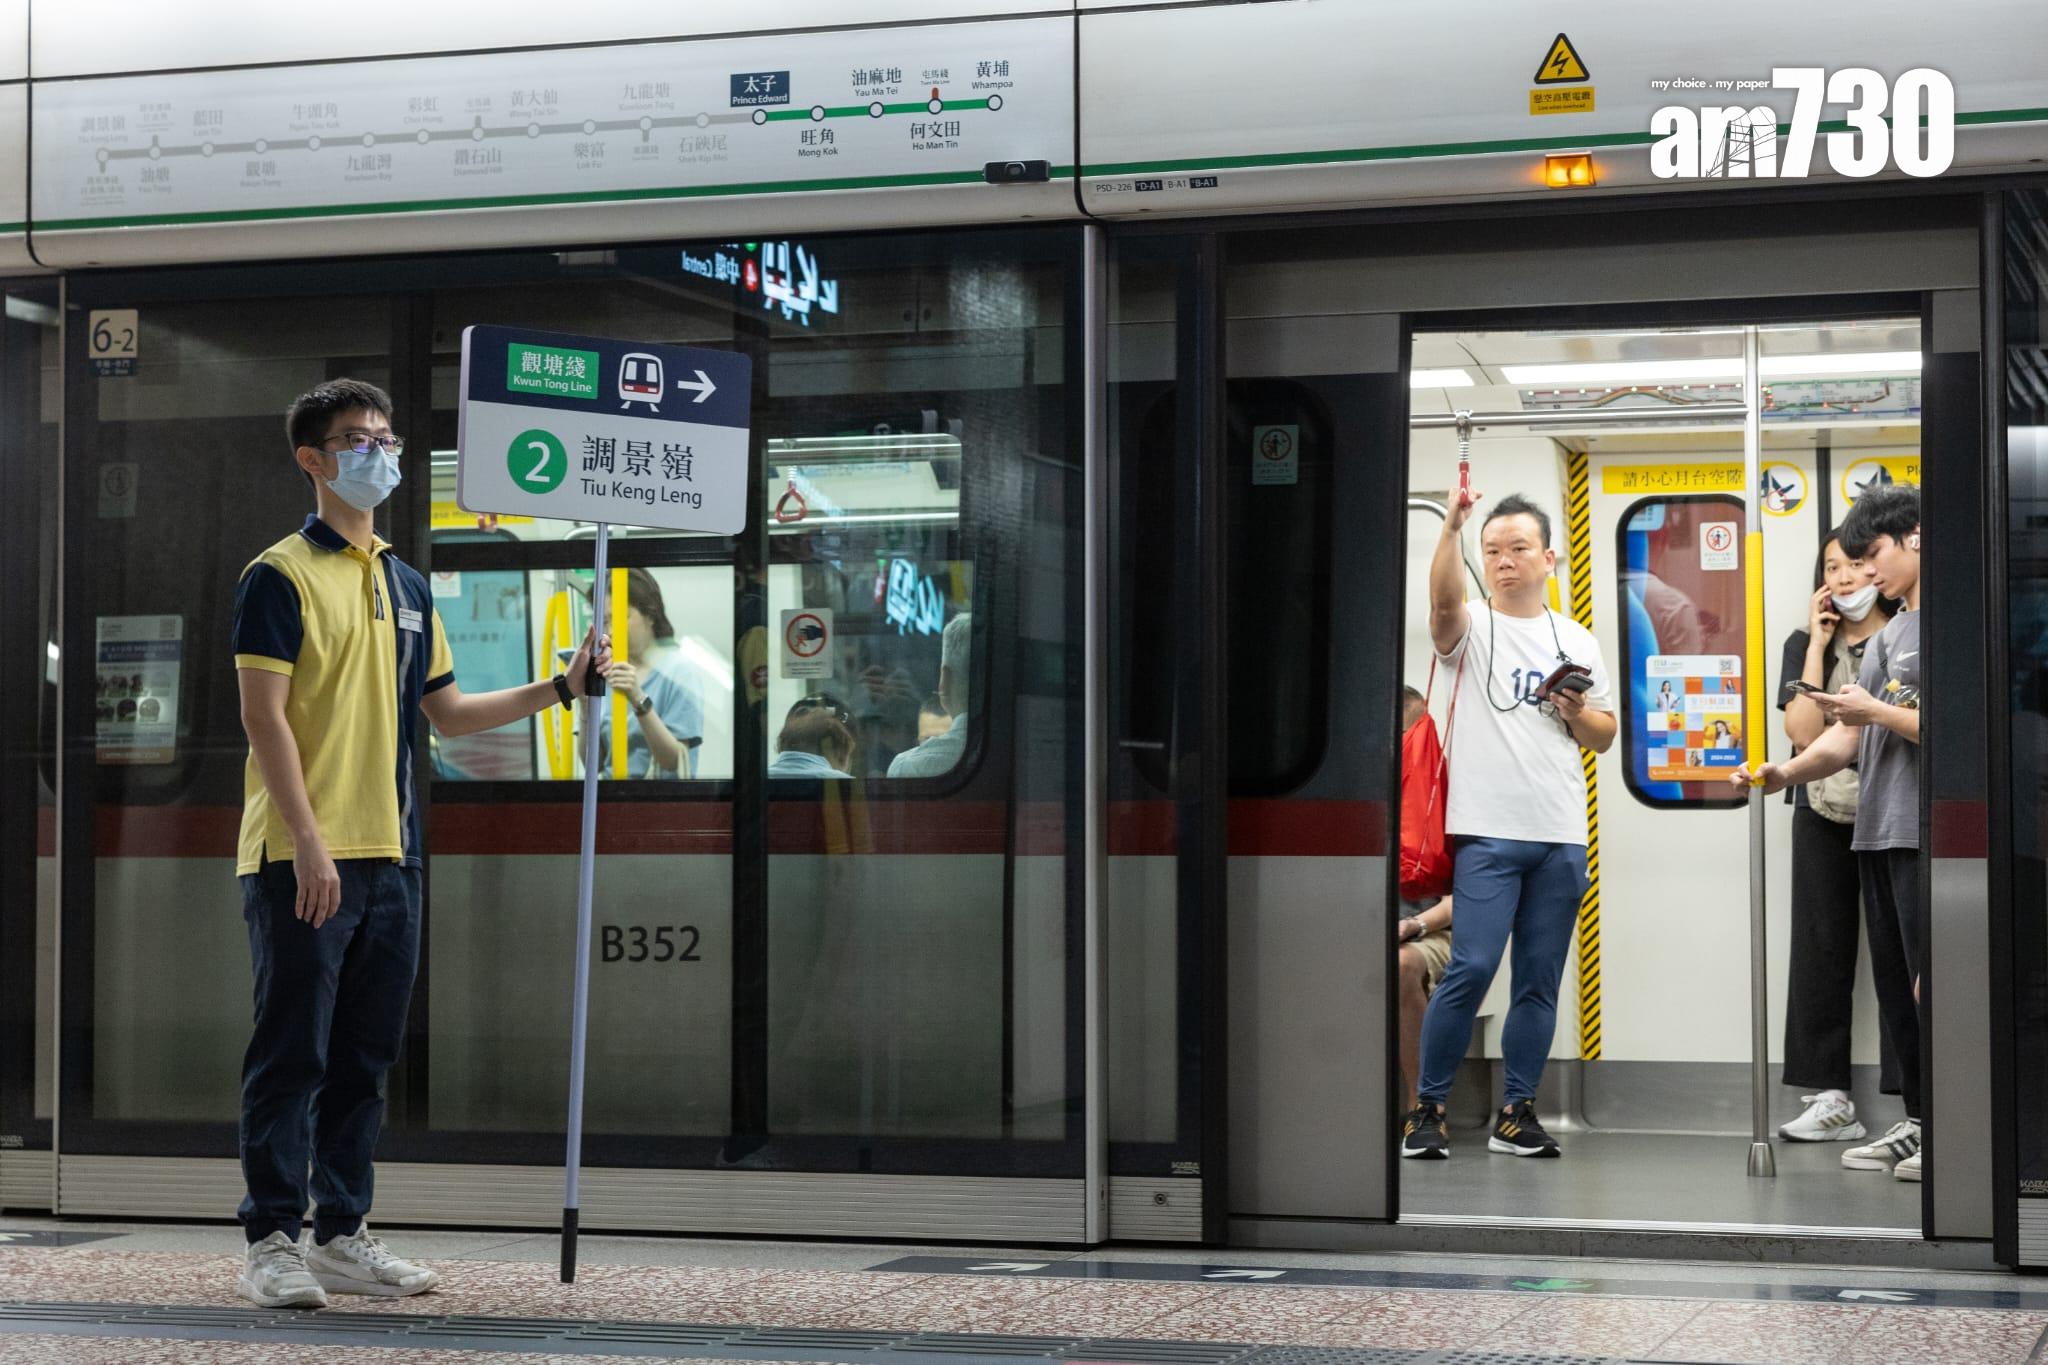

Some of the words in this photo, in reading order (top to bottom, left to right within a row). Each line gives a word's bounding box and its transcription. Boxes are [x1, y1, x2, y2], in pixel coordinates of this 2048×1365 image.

[852, 67, 902, 86] 油麻地
[976, 60, 1009, 78] 黃埔
[743, 75, 777, 94] 太子
[855, 89, 870, 97] Yau
[886, 86, 899, 95] Tei
[972, 81, 1013, 90] Whampoa
[511, 88, 558, 106] 黃大仙
[732, 97, 757, 105] Prince
[758, 94, 788, 103] Edward
[801, 129, 834, 146] 旺角
[911, 121, 960, 139] 何文田
[798, 148, 821, 159] Mong
[823, 147, 839, 156] Kok
[912, 143, 924, 151] Ho
[926, 141, 944, 149] Man
[946, 140, 959, 148] Tin
[94, 317, 133, 353] 6-2
[521, 351, 586, 378] 觀塘綫
[513, 375, 542, 387] Kwun
[543, 378, 569, 392] Tong
[570, 381, 592, 392] Line
[525, 441, 550, 483] 2
[581, 434, 694, 482] 調景嶺
[1623, 469, 1742, 488] 請小心月台空隙
[580, 477, 606, 496] Tiu
[612, 481, 655, 505] Keng
[661, 485, 702, 509] Leng
[1511, 668, 1543, 706] 10
[601, 925, 700, 962] B352
